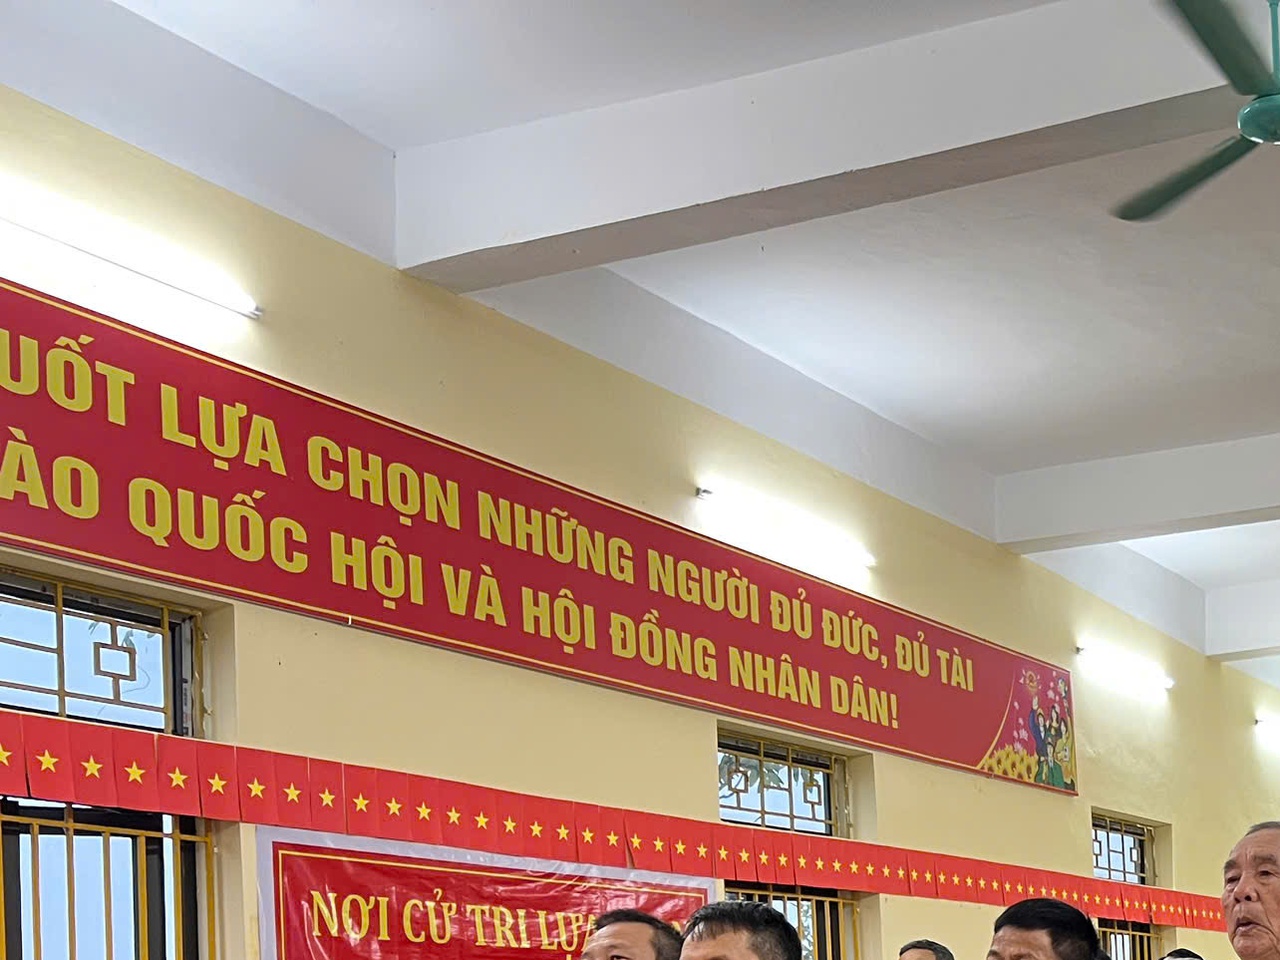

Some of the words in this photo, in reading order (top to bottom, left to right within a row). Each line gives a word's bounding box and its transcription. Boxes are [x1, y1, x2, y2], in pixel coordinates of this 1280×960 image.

[0, 327, 135, 426] UỐT
[160, 383, 287, 477] LỰA
[307, 436, 461, 530] CHỌN
[478, 491, 635, 584] NHỮNG
[648, 548, 760, 625] NGƯỜI
[770, 587, 813, 640] ĐỦ
[822, 607, 889, 670] ĐỨC,
[895, 631, 930, 678] ĐỦ
[937, 645, 974, 692] TÀI
[0, 426, 99, 519] ÀO
[128, 477, 309, 574] QUỐC
[330, 531, 424, 609] HỘI
[441, 562, 507, 627] VÀ
[522, 586, 596, 654] HỘI
[609, 609, 718, 681] ĐỒNG
[729, 645, 822, 710] NHÂN
[830, 674, 899, 730] DÂN!
[310, 889, 390, 942] NƠI
[403, 888, 458, 945] CỬ
[466, 903, 531, 949] TRI
